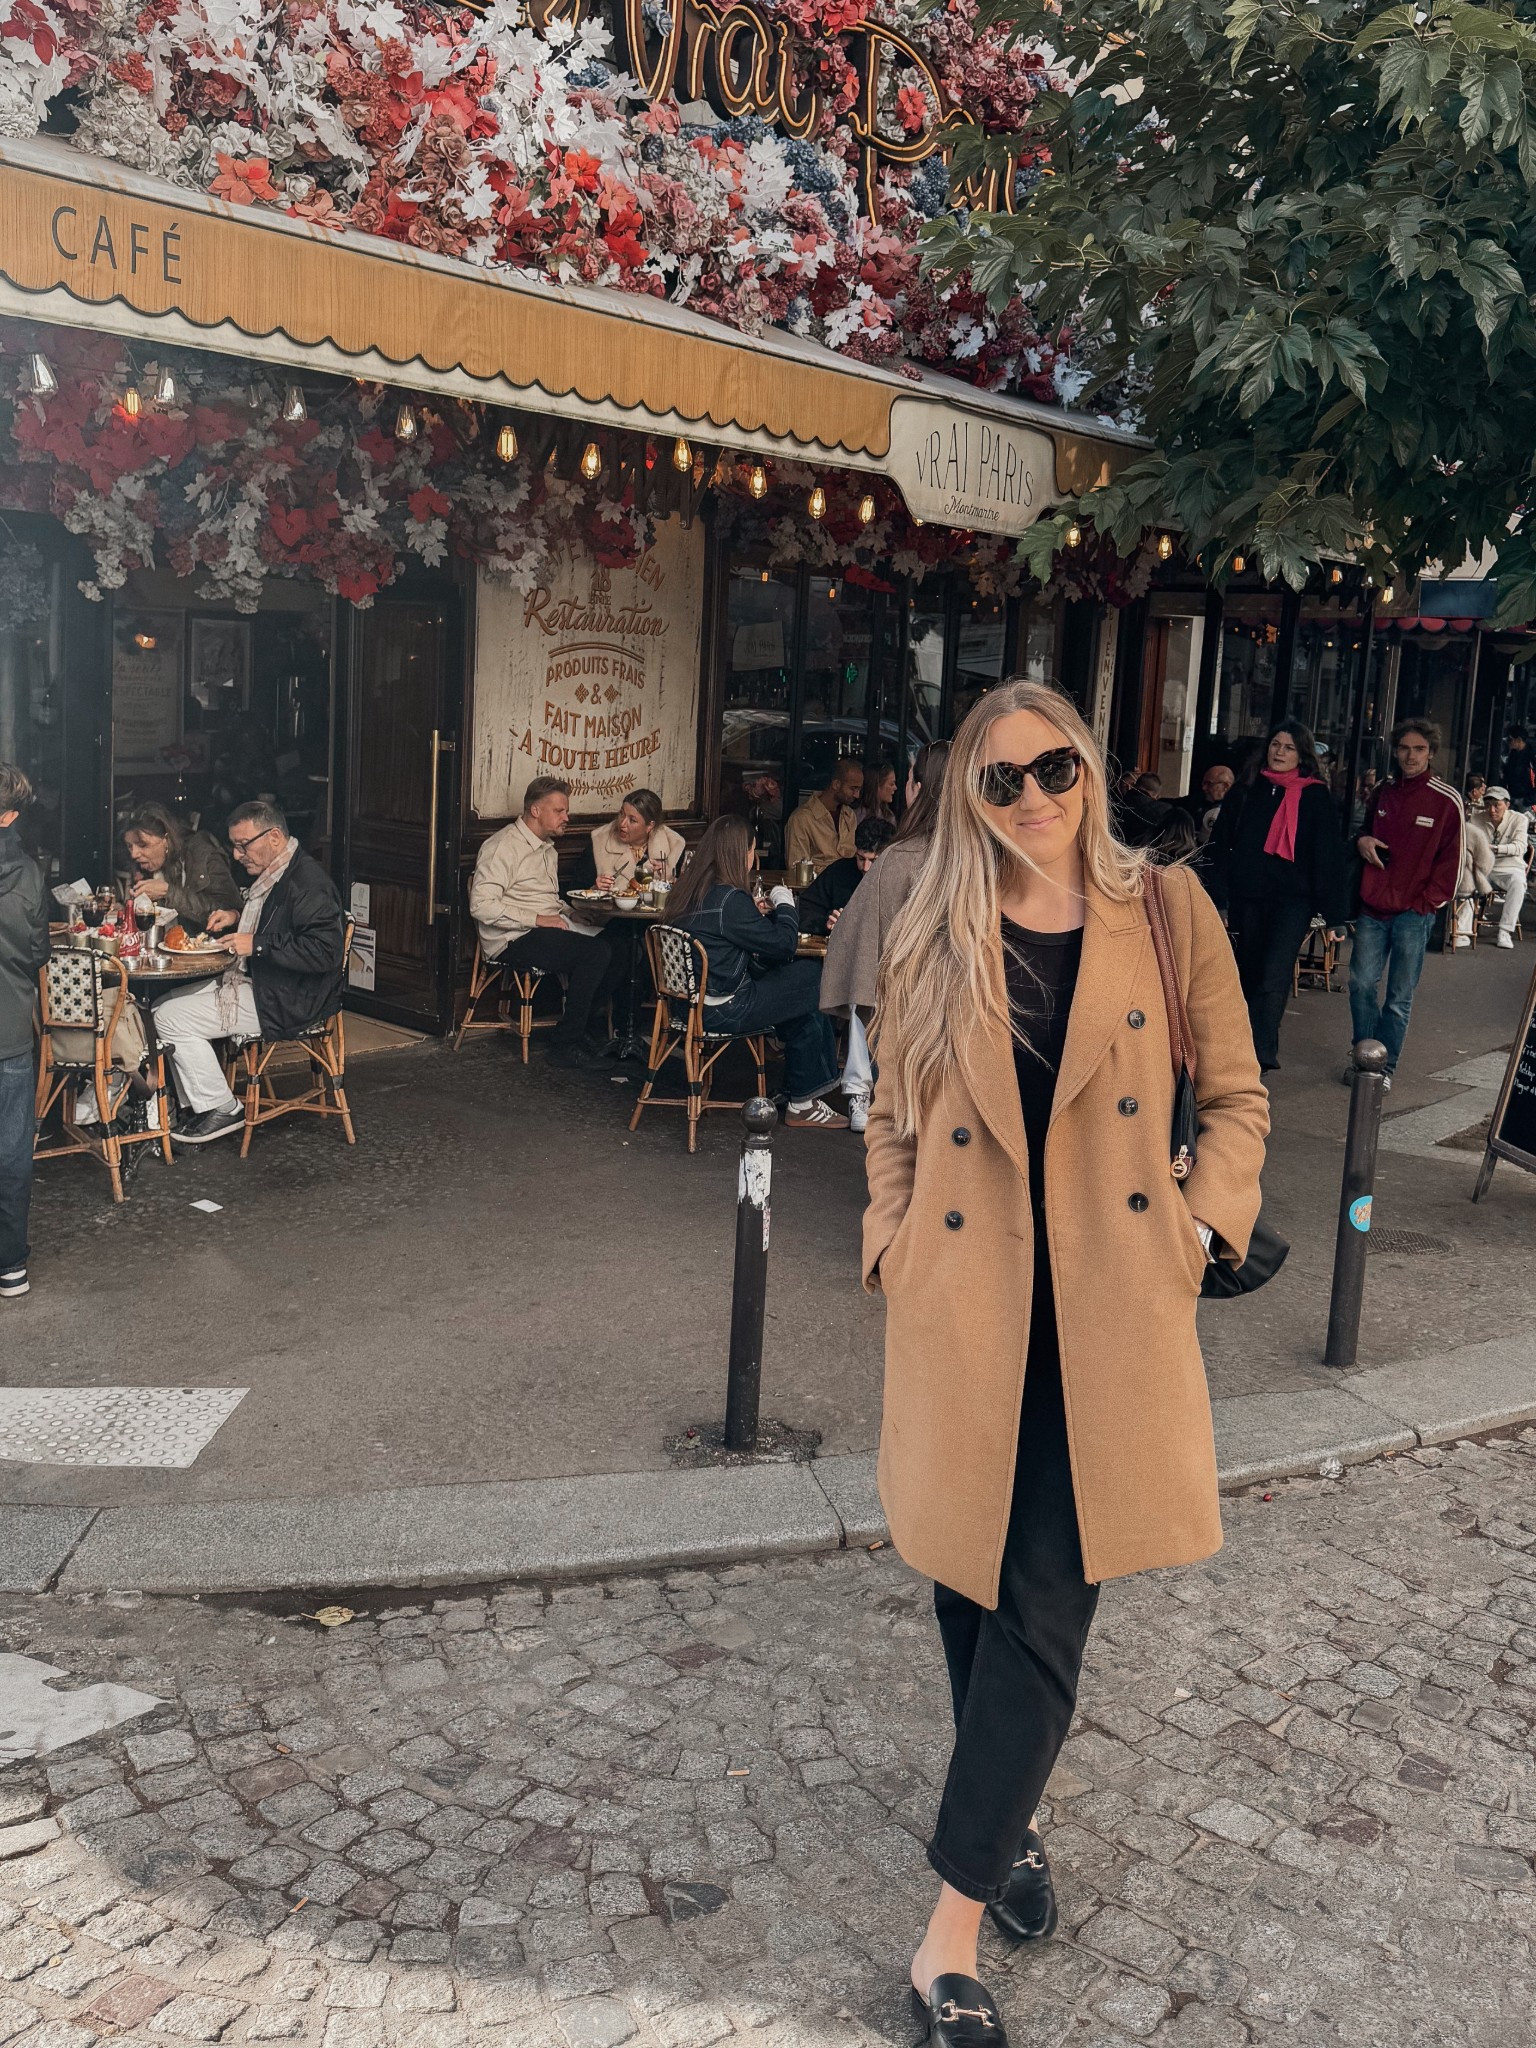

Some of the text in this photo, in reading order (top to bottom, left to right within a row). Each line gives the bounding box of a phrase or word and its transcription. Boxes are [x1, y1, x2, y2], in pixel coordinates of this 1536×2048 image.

[51, 205, 183, 286] CAFÉ
[915, 421, 1035, 508] VRAI PARIS
[943, 494, 1001, 522] Montmartre
[523, 585, 670, 637] Restauration
[545, 655, 646, 690] PRODUITS FRAIS
[589, 683, 603, 705] &
[1097, 608, 1115, 757] BIENVENU
[543, 699, 643, 739] FAIT MAISON
[538, 736, 601, 771] TOUTE
[602, 728, 662, 769] HEURE
